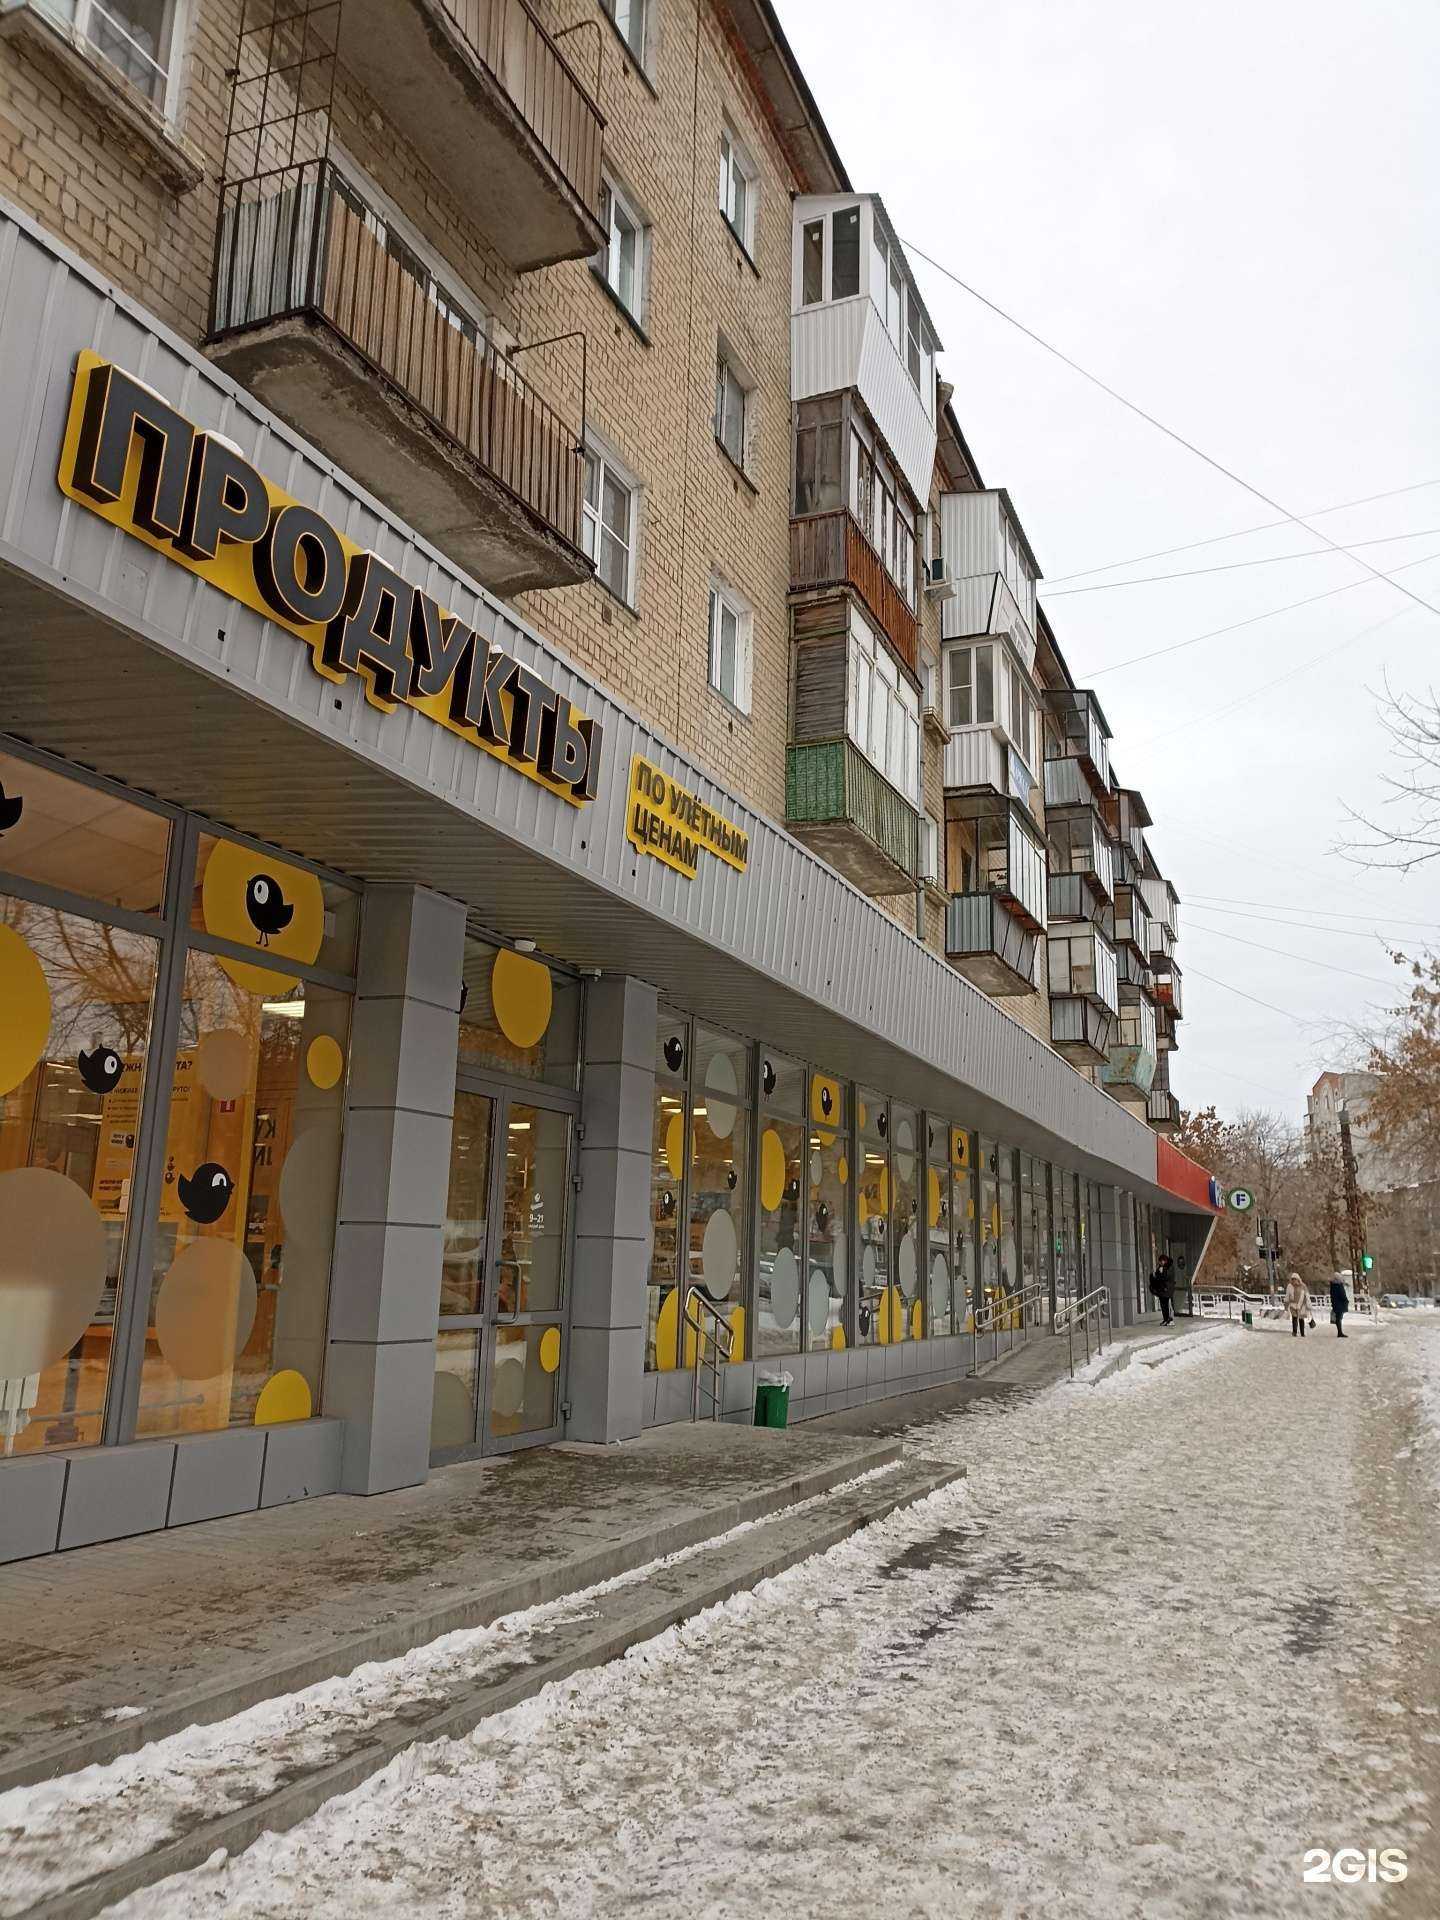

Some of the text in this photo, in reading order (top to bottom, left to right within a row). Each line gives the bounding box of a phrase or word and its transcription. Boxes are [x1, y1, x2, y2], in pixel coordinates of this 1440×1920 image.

[72, 363, 603, 801] ПРОДУКТЫ
[633, 802, 699, 871] ЦЕНАМ
[637, 760, 749, 864] ПО УЛЁТНЫМ
[1236, 1193, 1246, 1206] F
